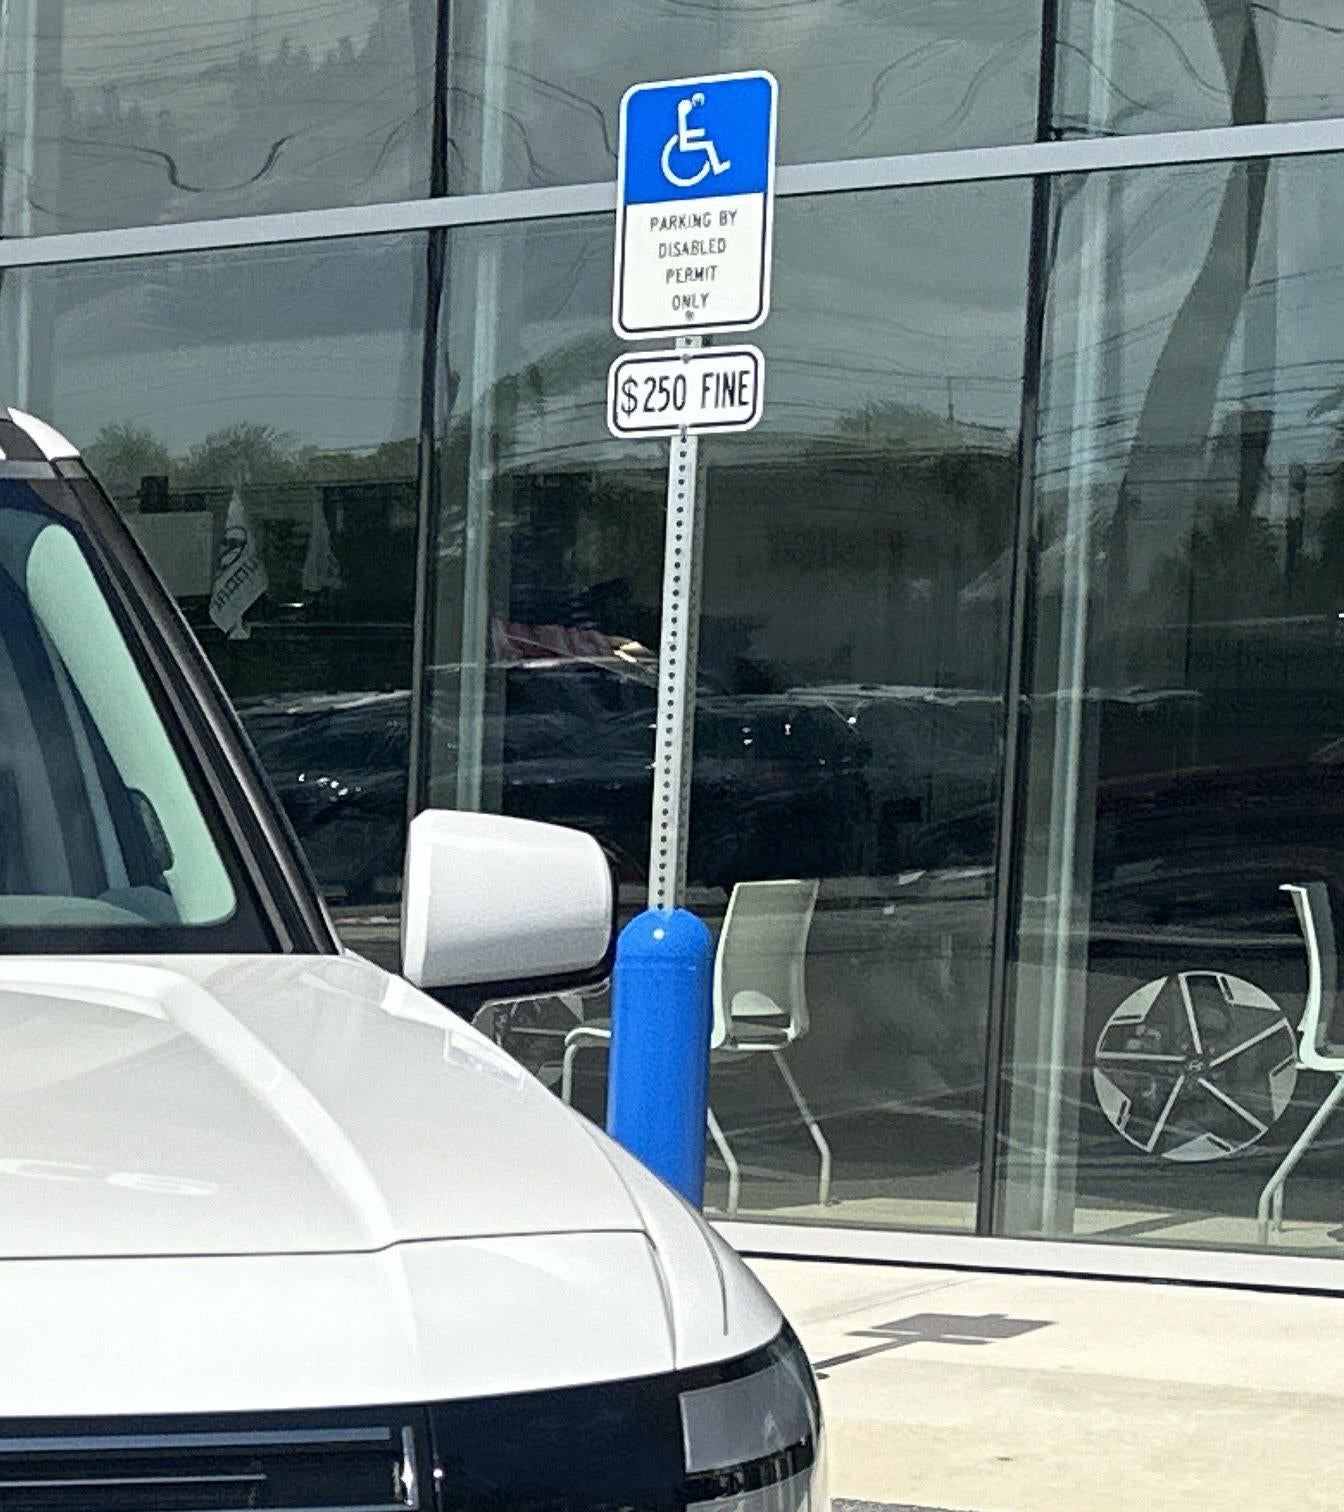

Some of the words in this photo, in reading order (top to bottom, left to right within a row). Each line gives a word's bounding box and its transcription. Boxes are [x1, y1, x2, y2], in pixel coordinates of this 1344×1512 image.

[650, 211, 712, 232] PARKING
[719, 209, 738, 227] BY
[658, 237, 727, 259] DISABLED
[665, 264, 719, 285] PERMIT
[672, 291, 710, 311] ONLY
[621, 373, 687, 418] $250
[700, 369, 751, 409] FINE
